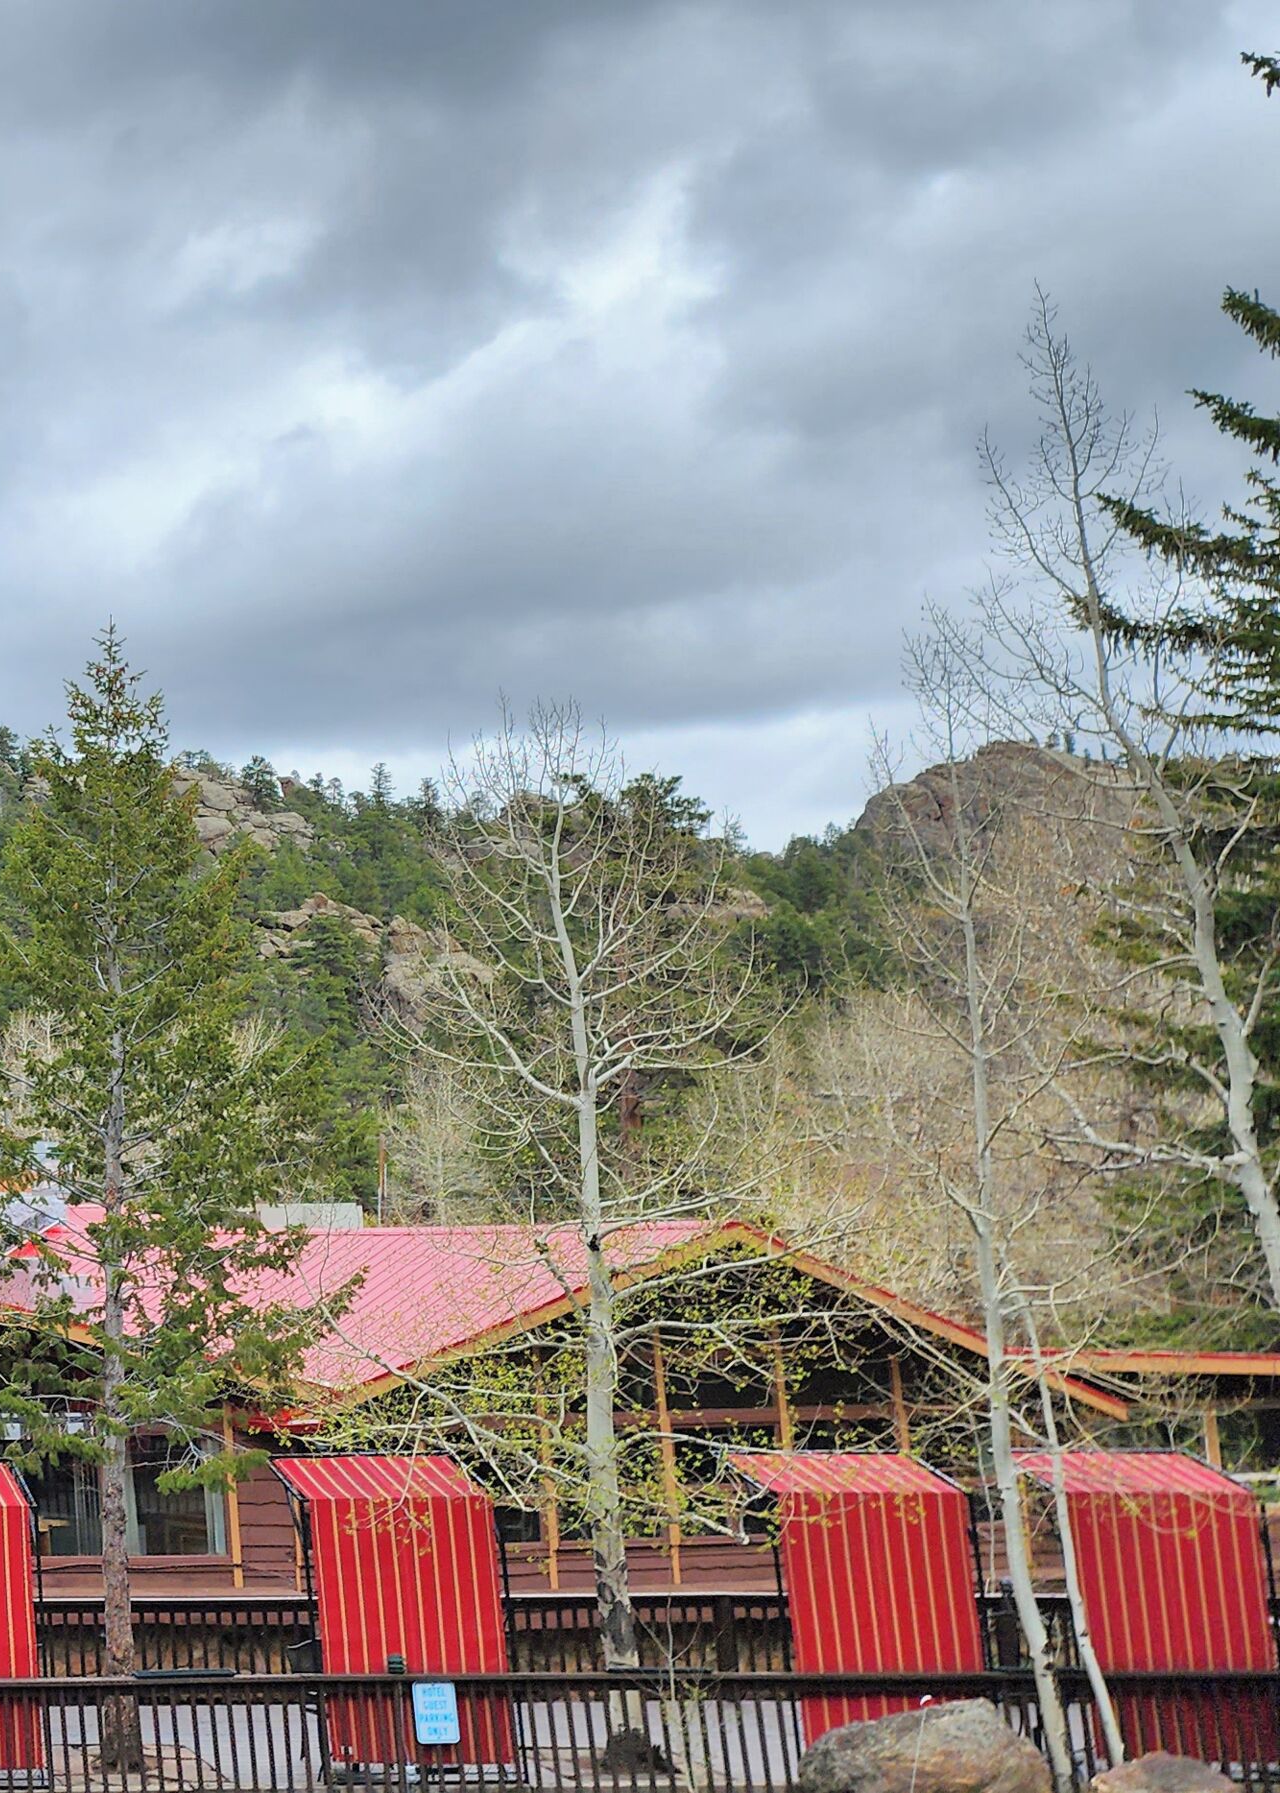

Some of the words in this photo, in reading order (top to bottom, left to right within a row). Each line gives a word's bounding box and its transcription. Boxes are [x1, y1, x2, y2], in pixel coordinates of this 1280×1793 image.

[422, 1687, 445, 1697] HOTEL
[424, 1700, 447, 1710] GUEST
[419, 1713, 455, 1722] PARKING
[427, 1726, 448, 1736] ONLY
